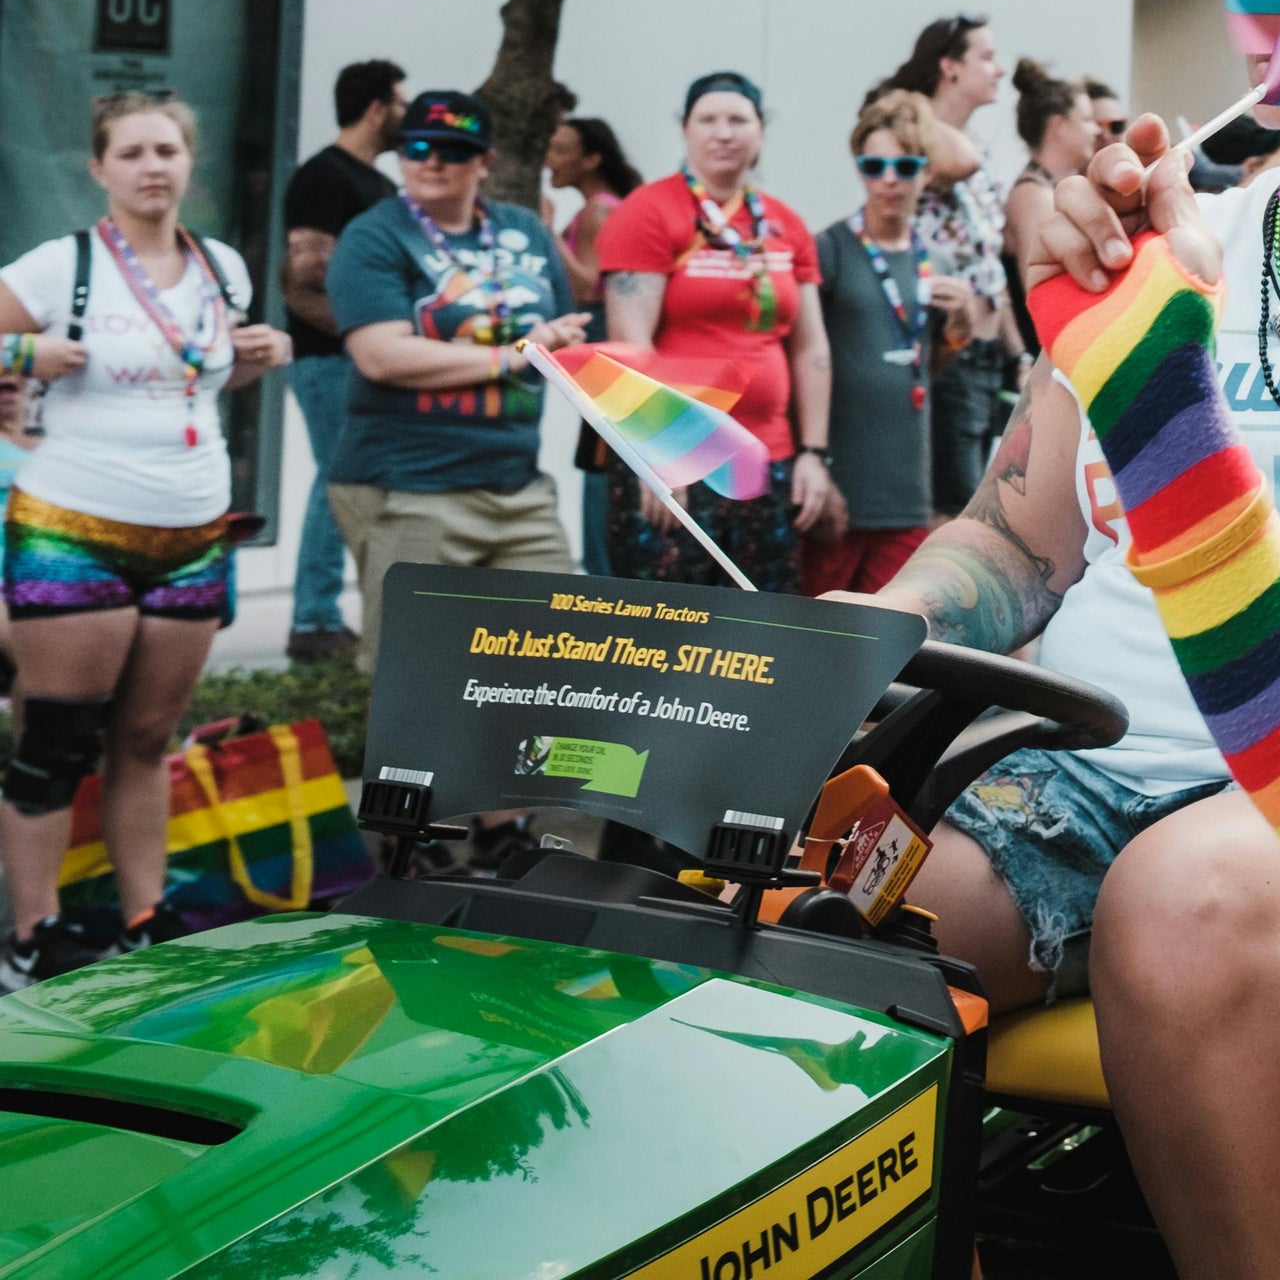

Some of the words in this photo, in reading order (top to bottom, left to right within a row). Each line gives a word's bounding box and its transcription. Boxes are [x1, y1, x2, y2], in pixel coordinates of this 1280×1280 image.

[550, 593, 574, 610] 100
[572, 595, 614, 614] Series
[613, 599, 652, 618] Lawn
[654, 603, 710, 624] Tractors
[469, 627, 520, 656] Don't
[516, 630, 555, 658] Just
[552, 632, 613, 662] Stand
[611, 637, 669, 673] There,
[672, 644, 713, 674] SIT
[709, 649, 775, 685] HERE.
[463, 678, 534, 708] Experience
[534, 682, 557, 706] the
[557, 684, 619, 712] Comfort
[618, 691, 643, 714] of
[637, 699, 651, 716] a
[650, 696, 695, 723] John
[696, 702, 751, 732] Deere.
[806, 1131, 920, 1241] DEERE
